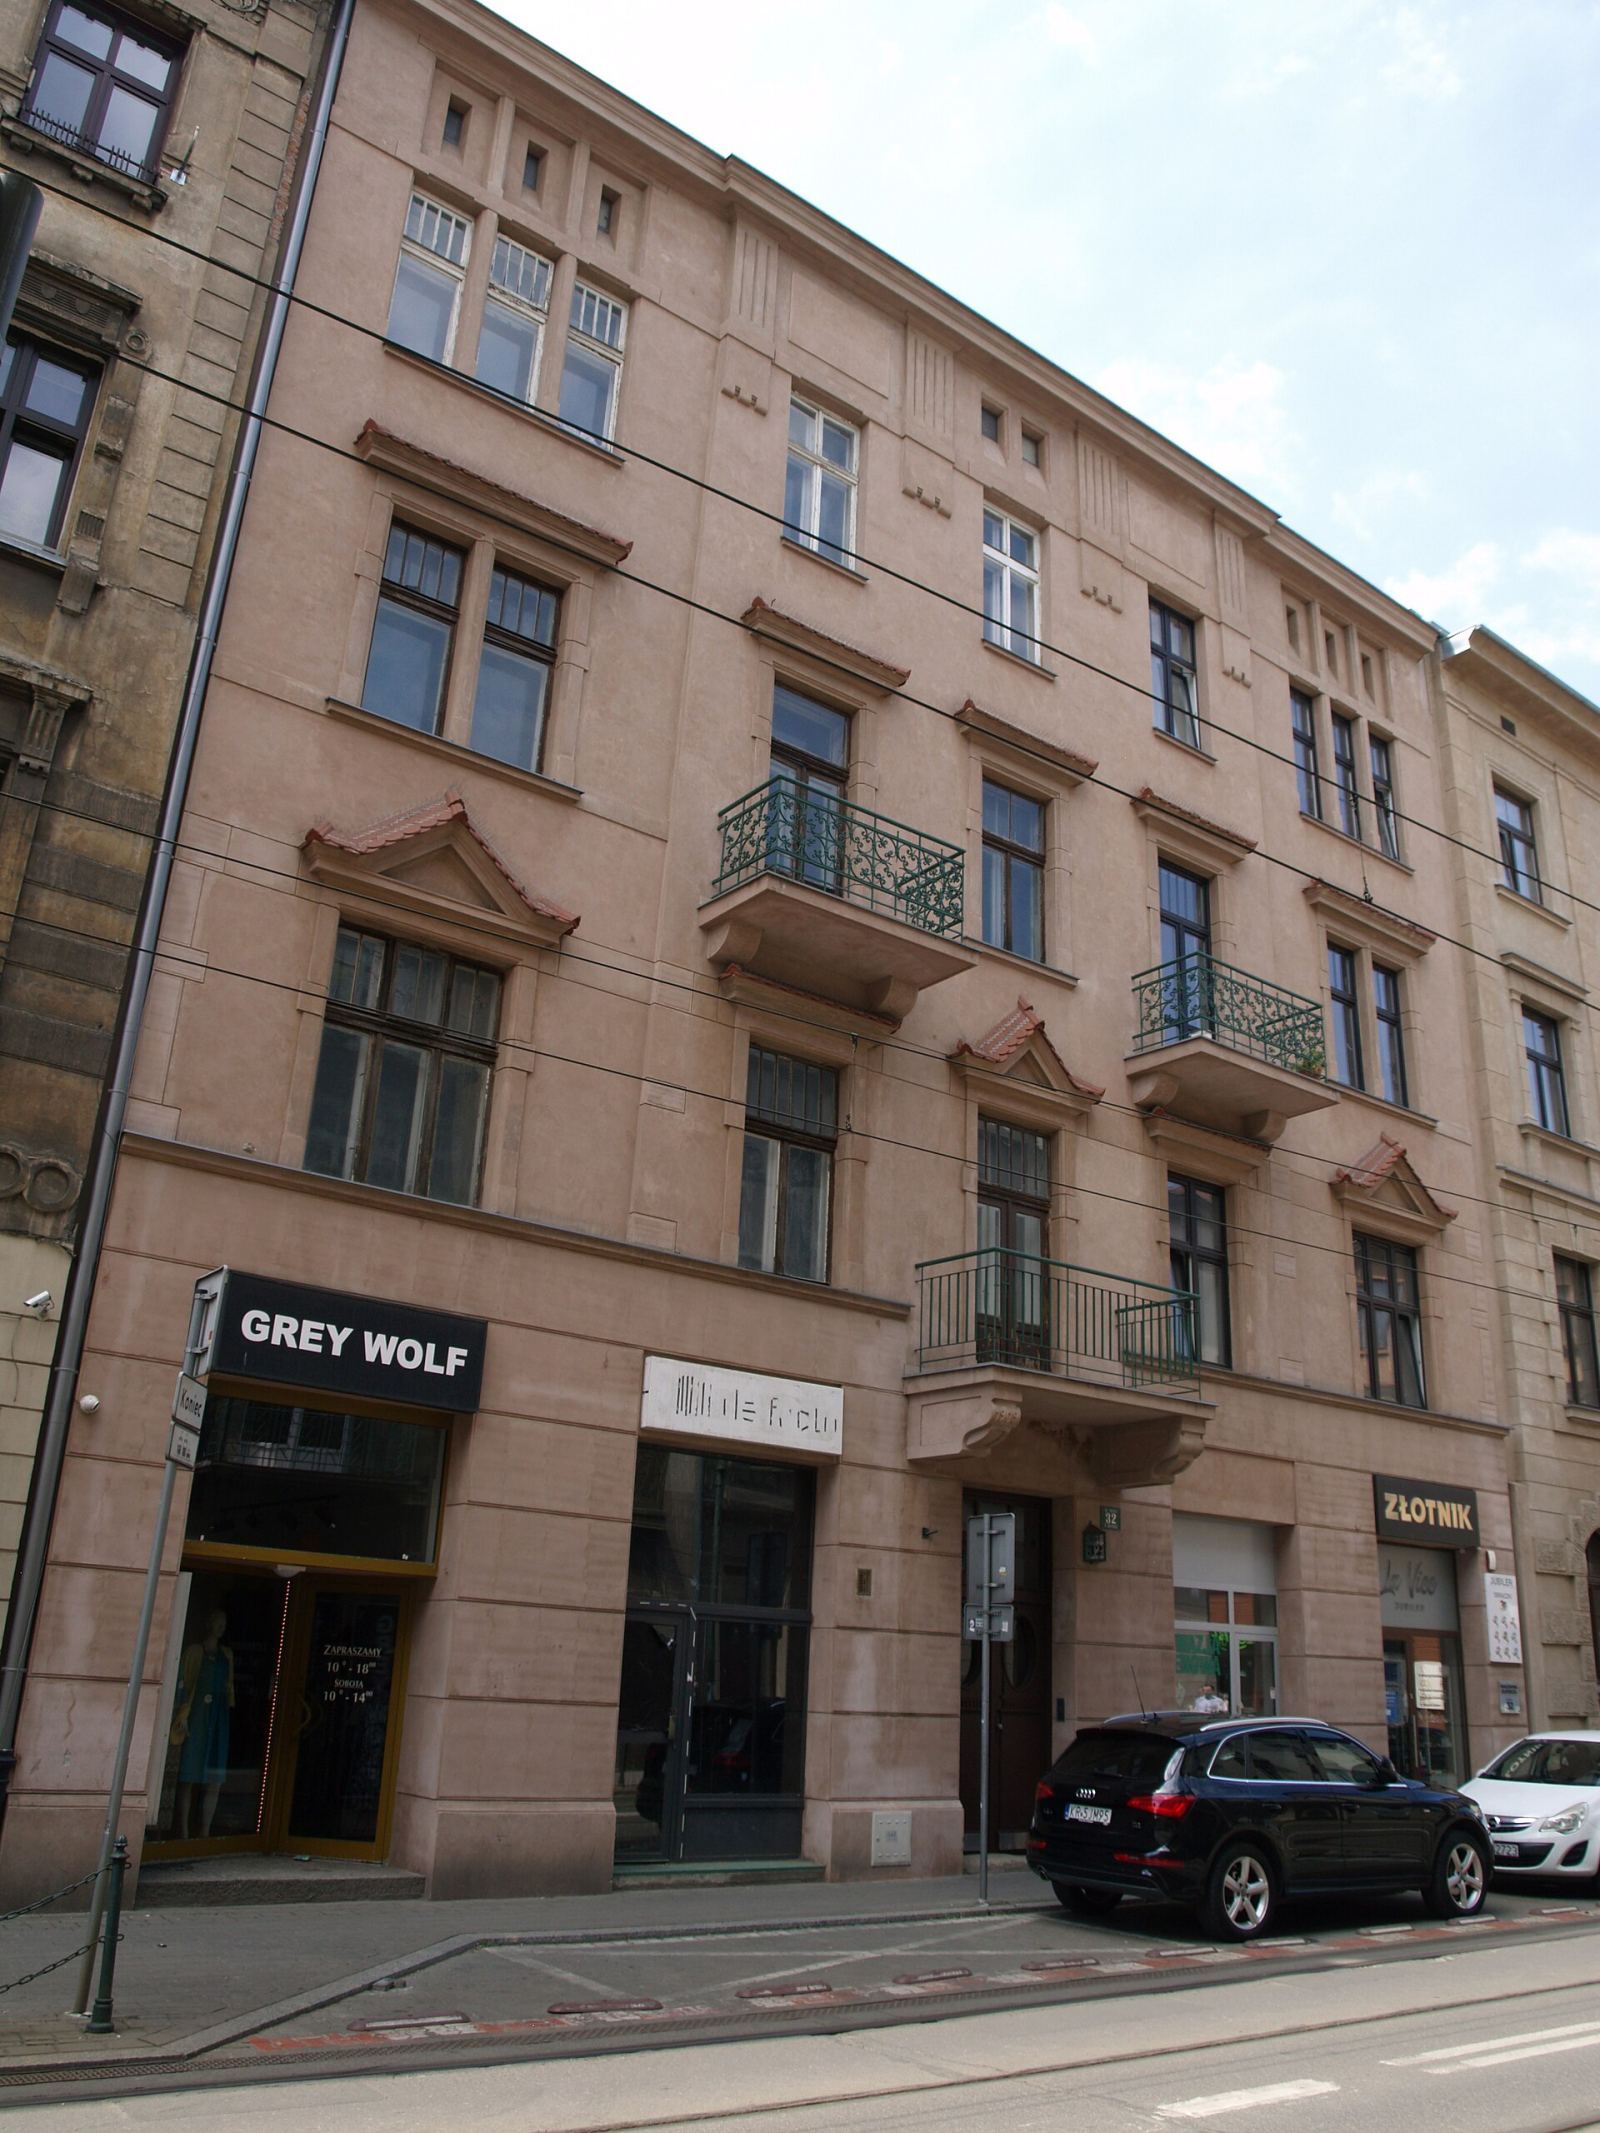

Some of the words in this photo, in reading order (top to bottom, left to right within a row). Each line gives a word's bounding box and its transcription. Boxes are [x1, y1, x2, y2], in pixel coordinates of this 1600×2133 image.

[241, 1309, 354, 1357] GREY
[363, 1331, 468, 1376] WOLF
[180, 1388, 202, 1418] Koniec
[1105, 1512, 1117, 1525] 32
[1384, 1492, 1474, 1531] ZŁOTNIK
